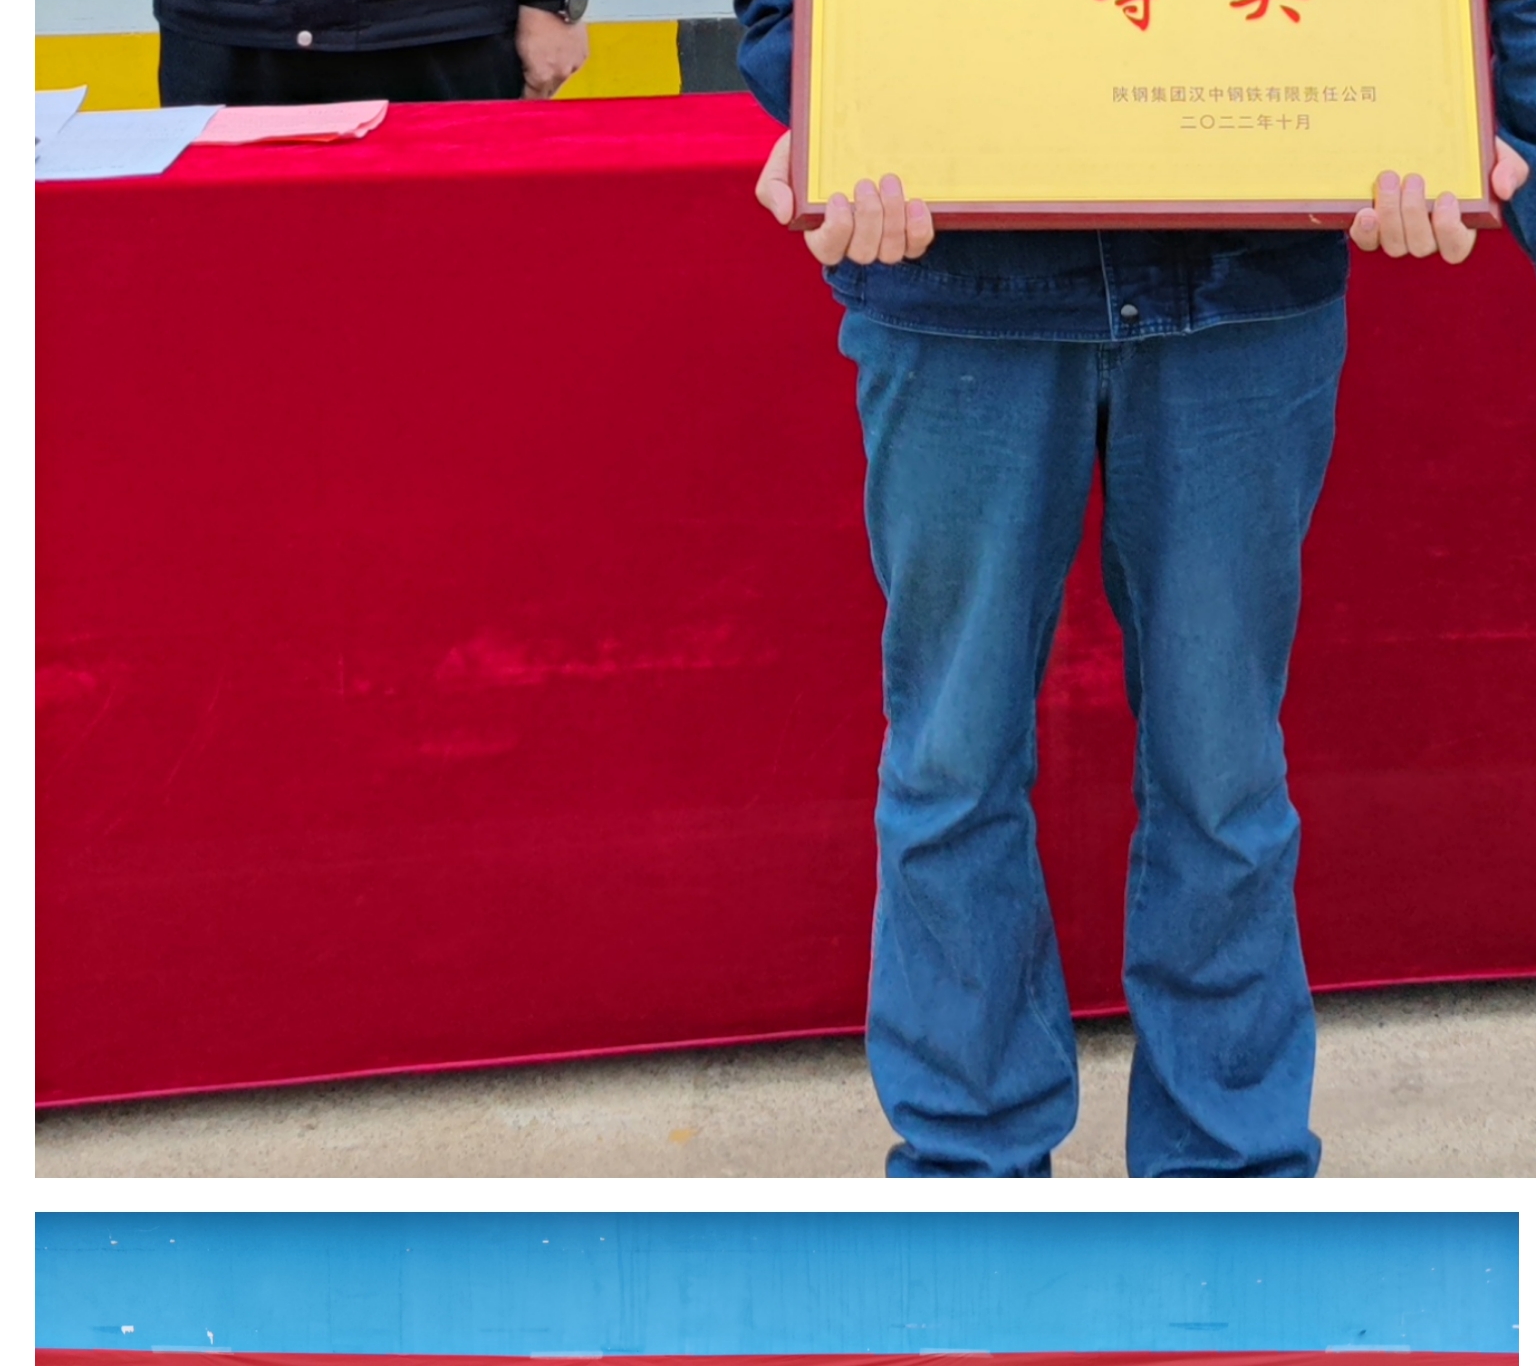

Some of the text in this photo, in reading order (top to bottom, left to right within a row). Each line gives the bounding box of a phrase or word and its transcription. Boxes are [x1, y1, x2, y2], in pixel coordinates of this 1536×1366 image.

[1111, 85, 1378, 105] 陕钢集团汉中钢铁有限责任公司
